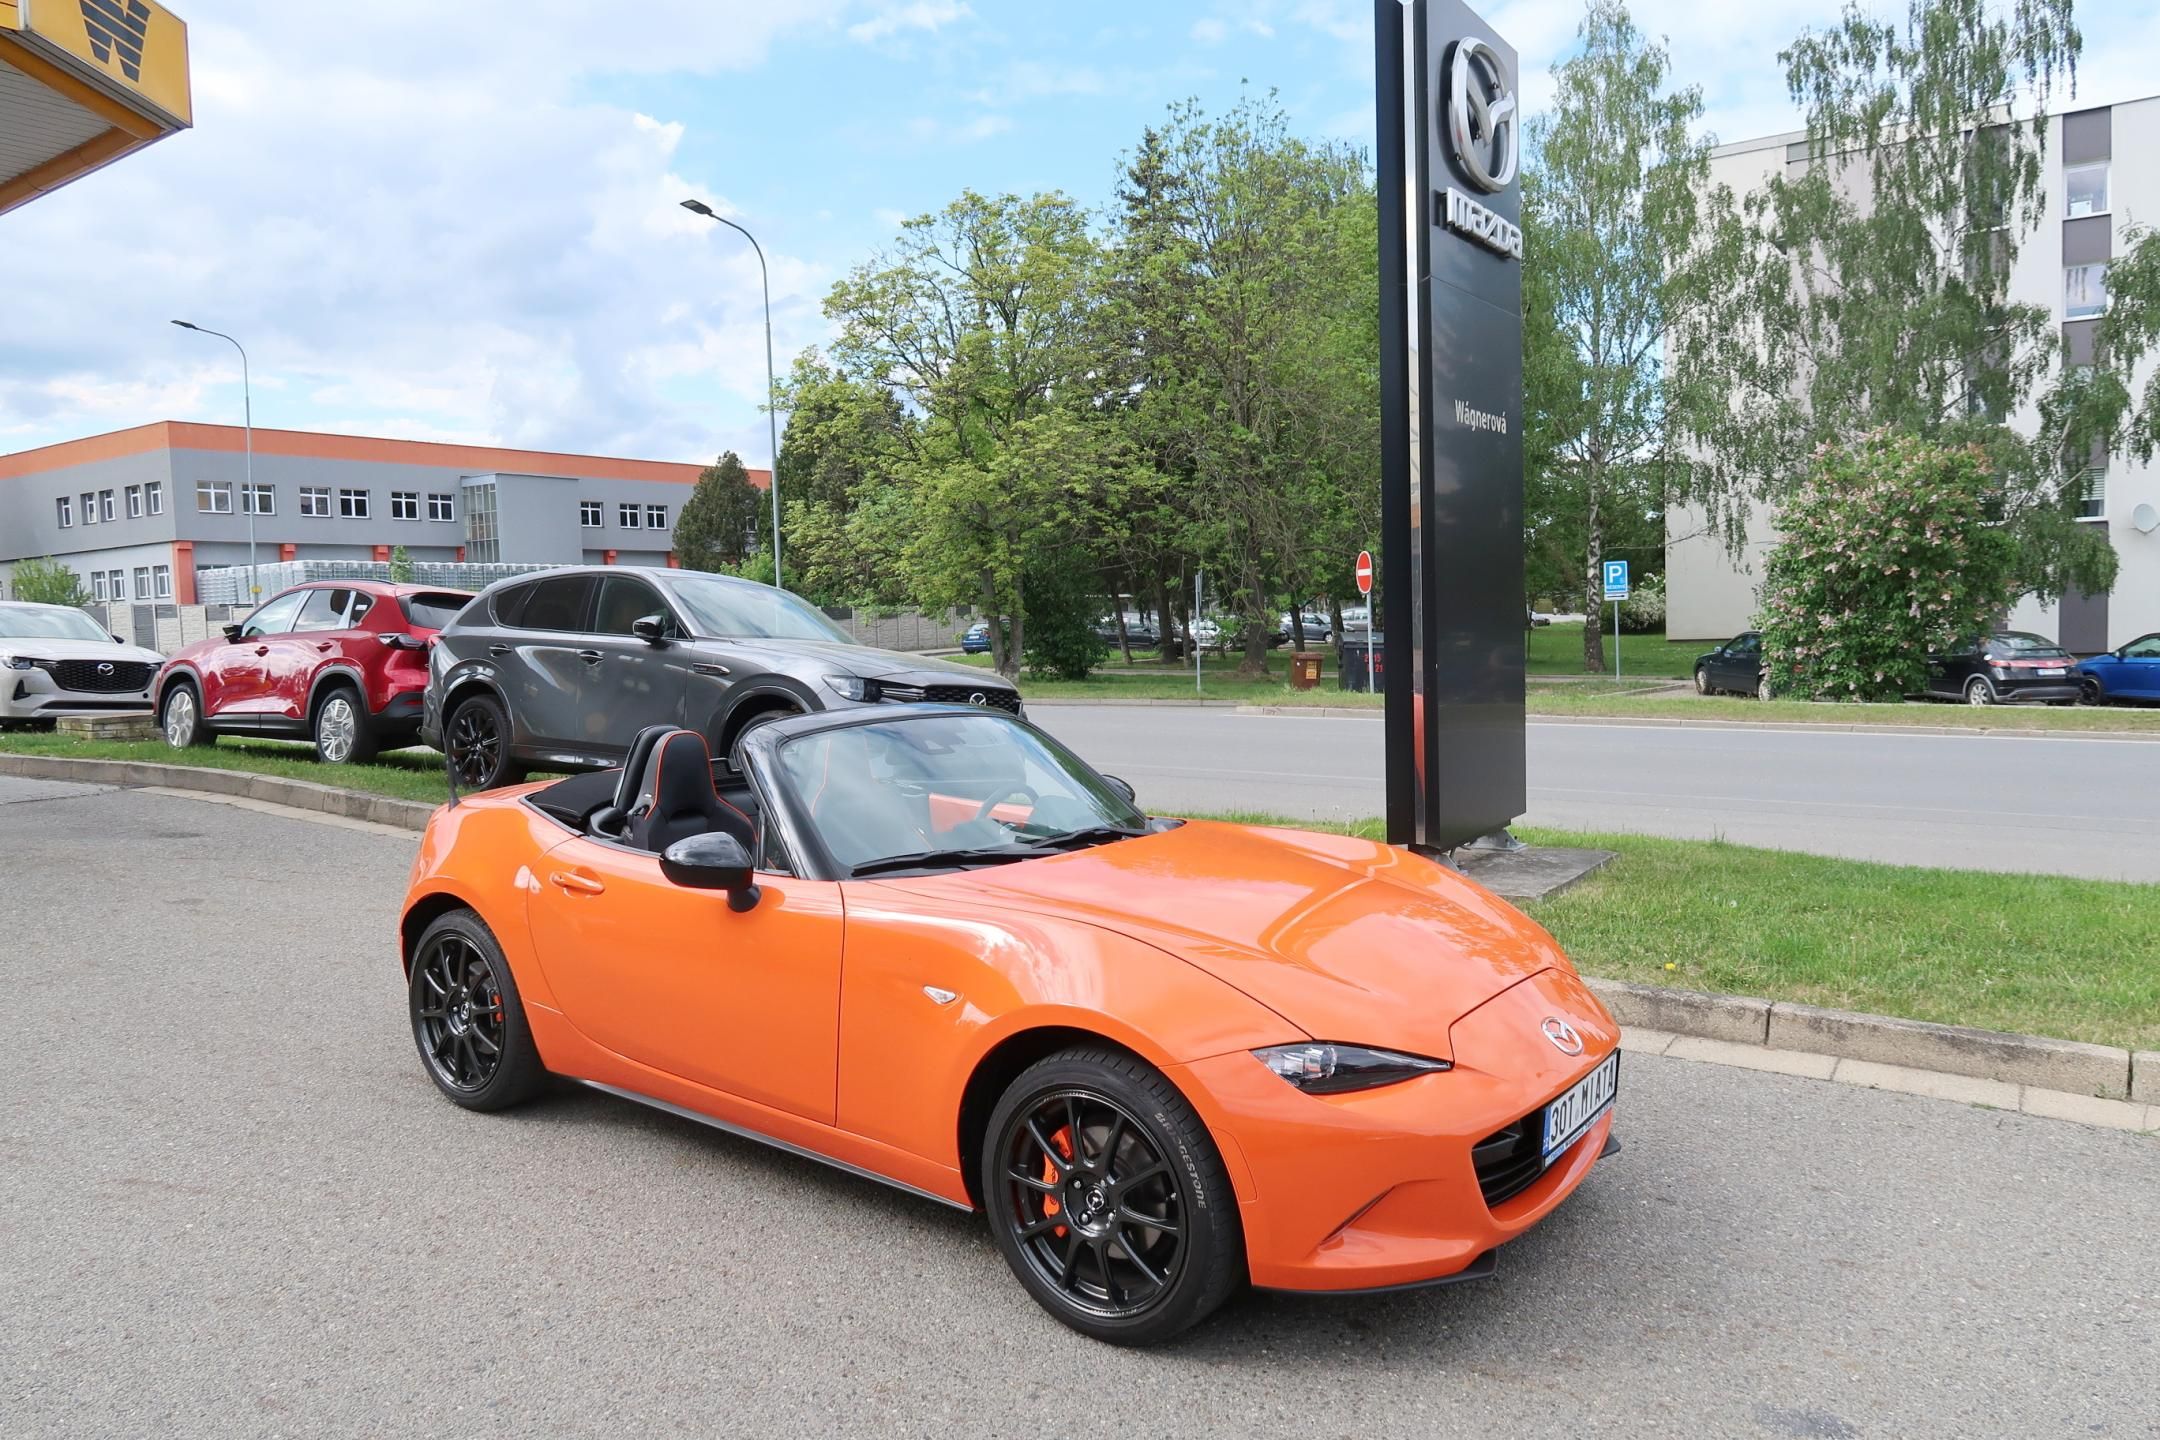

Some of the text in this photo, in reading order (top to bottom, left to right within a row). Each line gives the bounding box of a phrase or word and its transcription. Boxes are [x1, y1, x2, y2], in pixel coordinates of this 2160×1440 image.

[1447, 187, 1523, 260] mazda
[1454, 399, 1507, 435] Wágnerová
[1608, 565, 1622, 584] P
[1580, 1060, 1614, 1117] MIATA
